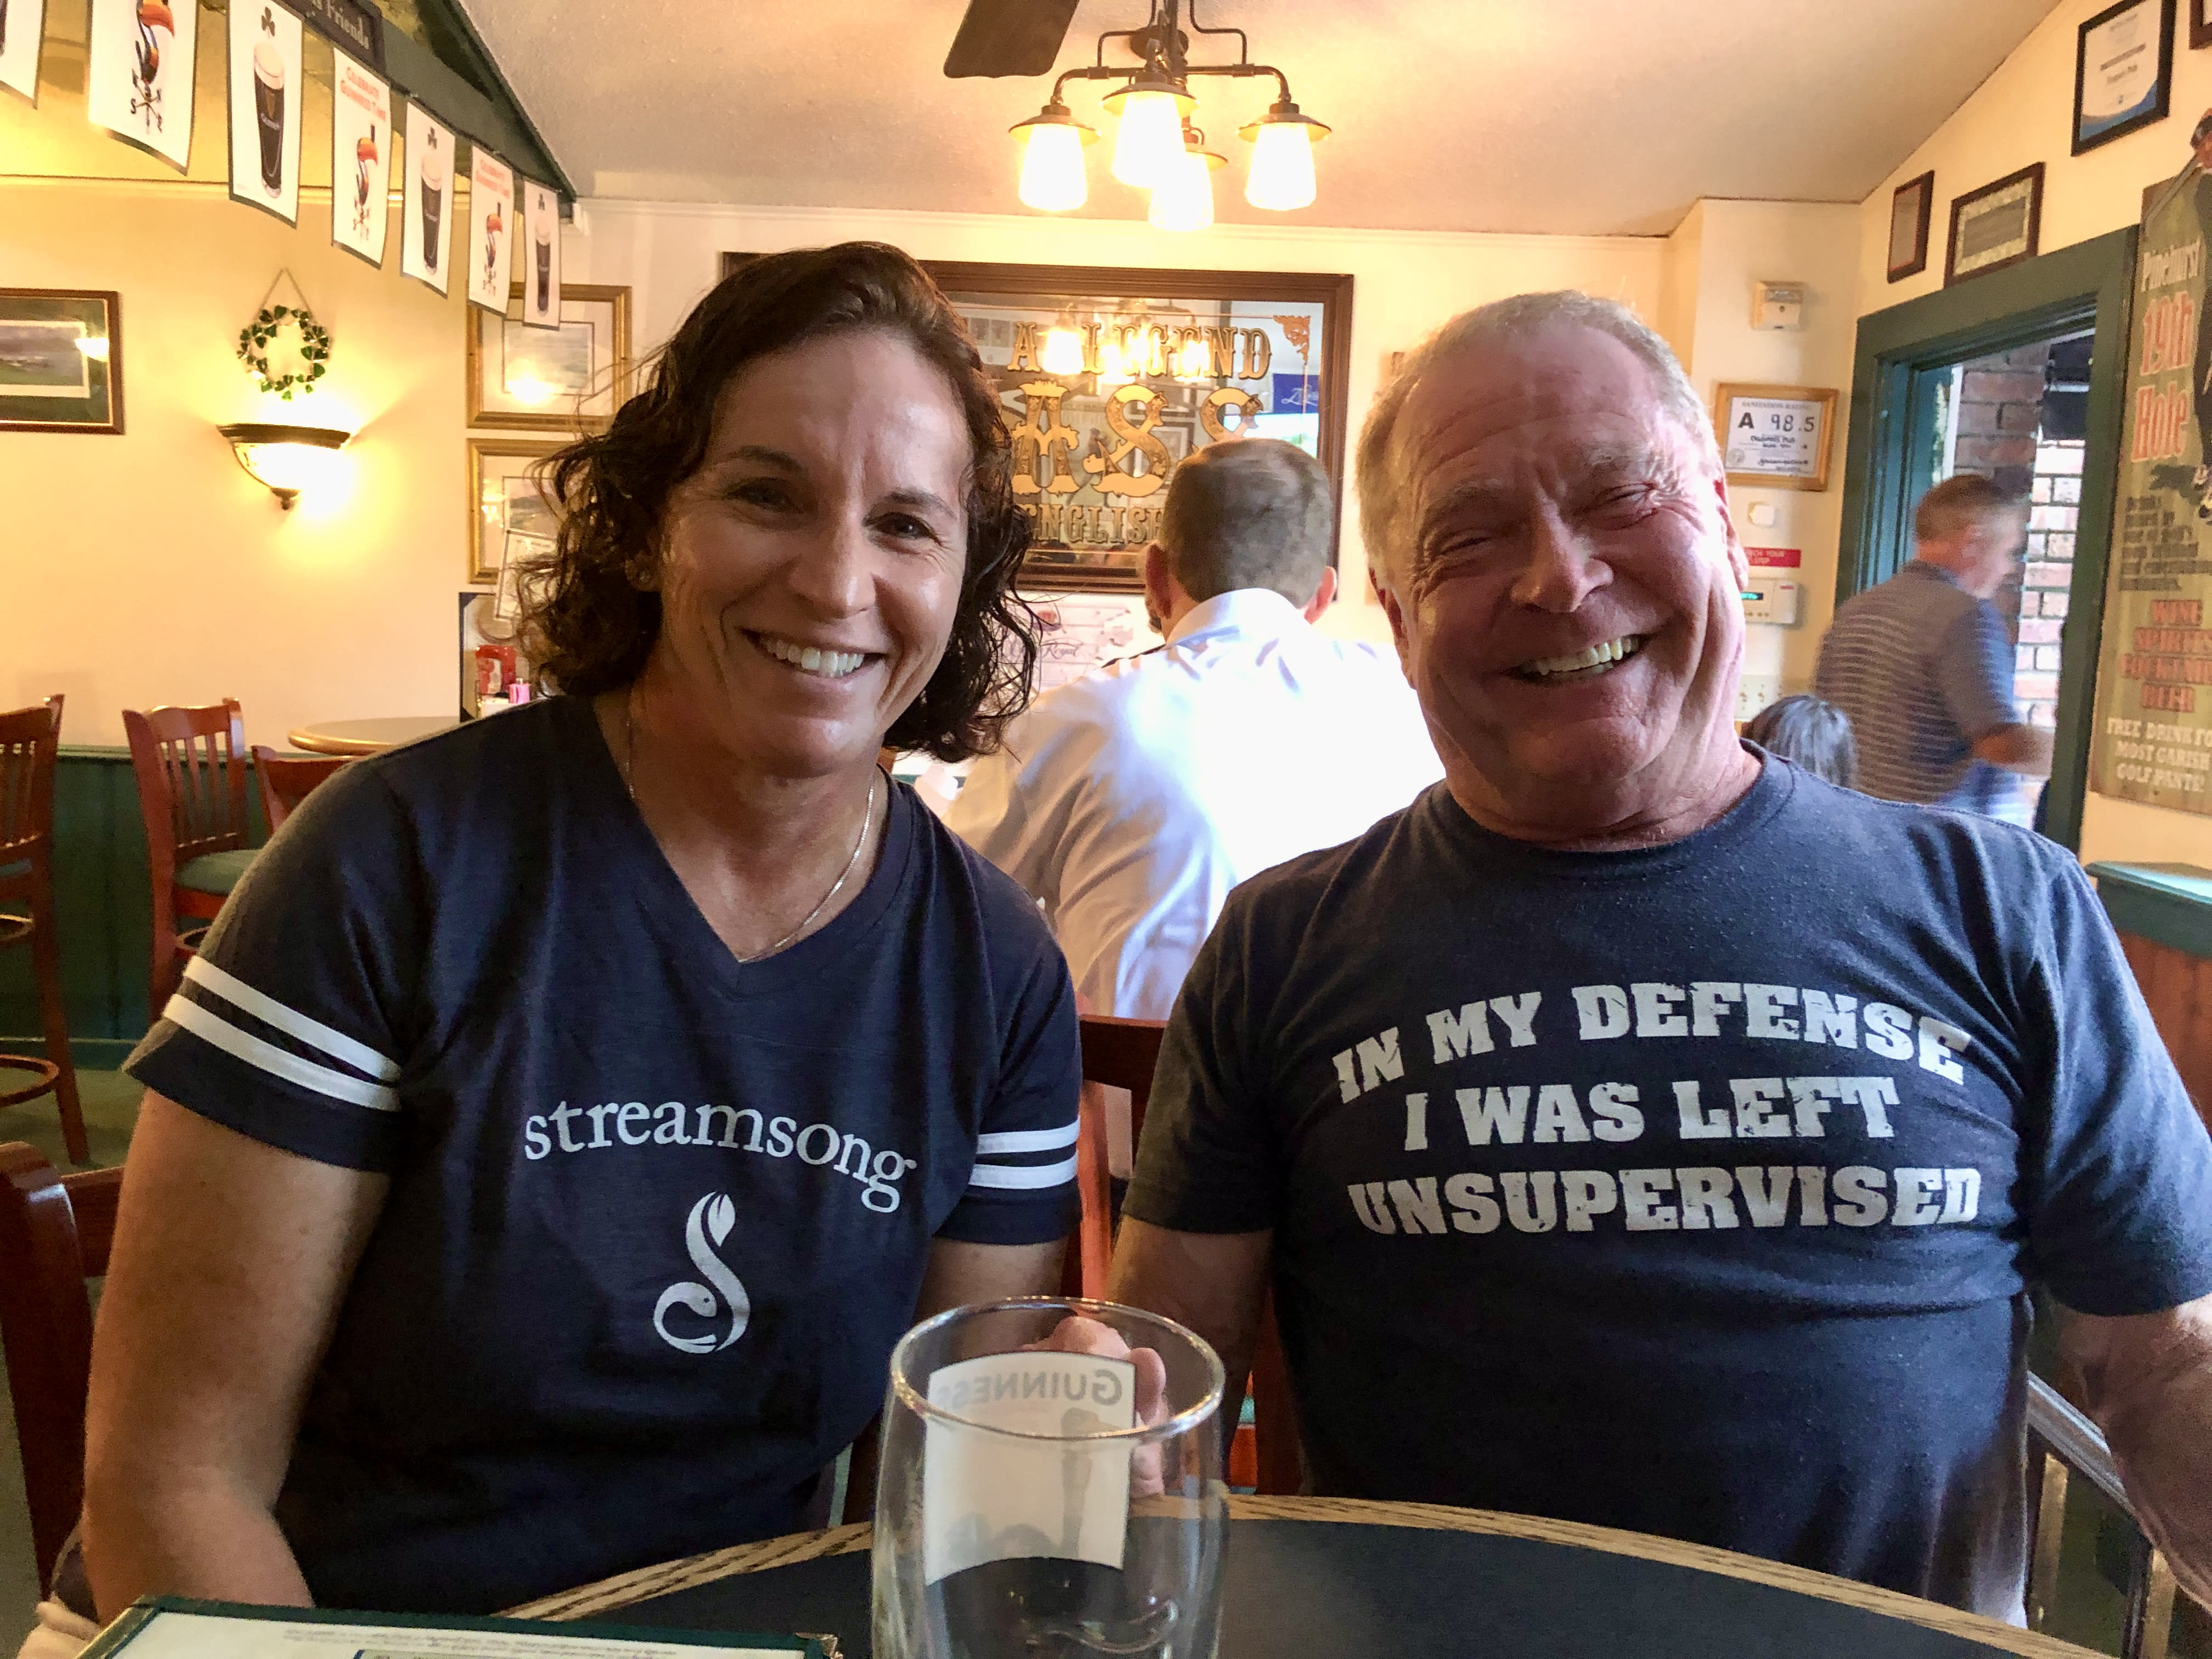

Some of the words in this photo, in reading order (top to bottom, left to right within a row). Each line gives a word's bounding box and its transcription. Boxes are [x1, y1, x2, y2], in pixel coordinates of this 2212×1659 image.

[1007, 321, 1042, 373] A
[1082, 321, 1272, 380] LEGEND
[2140, 291, 2194, 376] 19th
[1737, 412, 1754, 429] A
[2131, 381, 2190, 462] Hole
[1042, 641, 1081, 659] Royal
[2107, 716, 2141, 738] FREE
[2146, 721, 2192, 745] DRINK
[2115, 740, 2154, 763] MOST
[2156, 746, 2210, 771] GARISH
[2117, 763, 2153, 783] GOLF
[1332, 1026, 1405, 1104] IN
[1426, 991, 1542, 1065] MY
[1571, 981, 1972, 1085] DEFENSE
[1404, 1092, 1429, 1151] I
[1455, 1082, 1645, 1146] WAS
[1672, 1076, 1901, 1139] LEFT
[524, 1100, 917, 1213] streamsong
[1346, 1165, 1981, 1234] UNSUPERVISED
